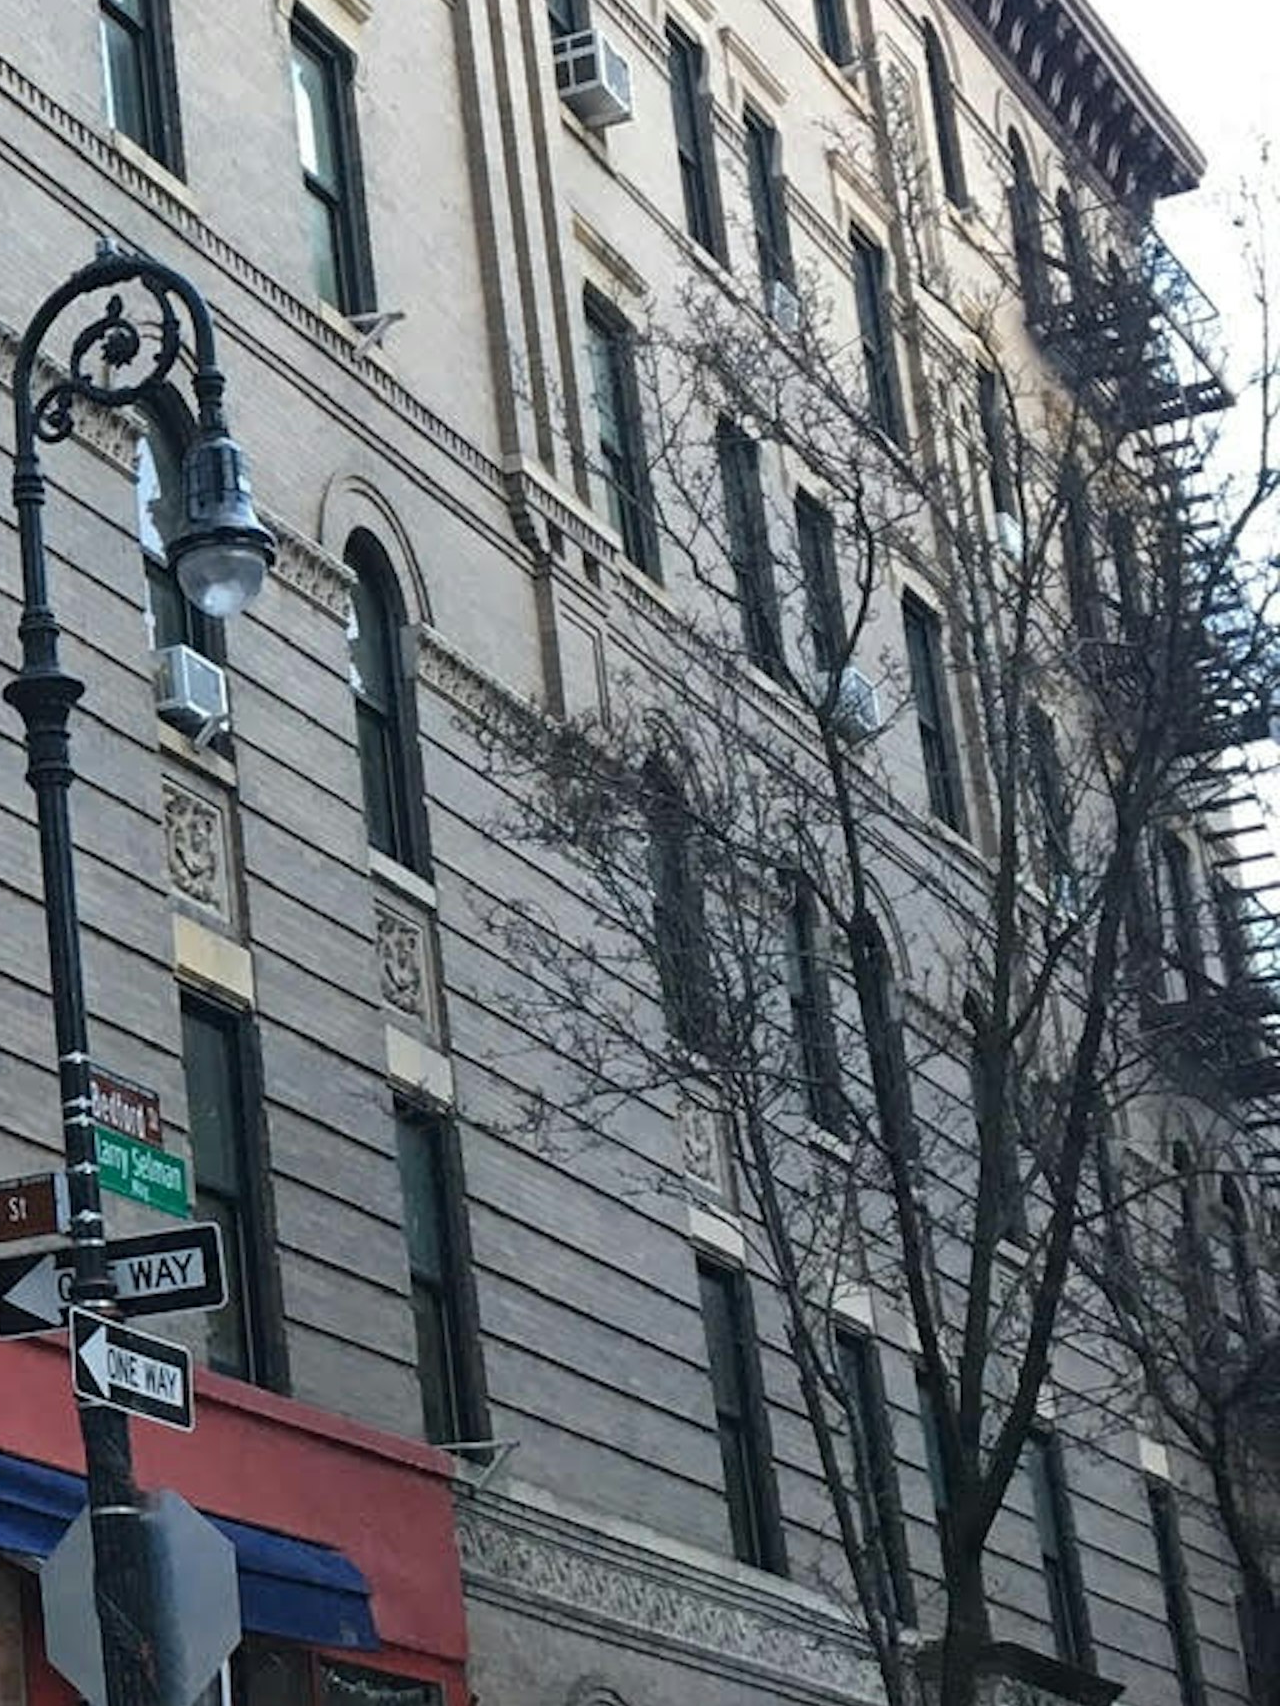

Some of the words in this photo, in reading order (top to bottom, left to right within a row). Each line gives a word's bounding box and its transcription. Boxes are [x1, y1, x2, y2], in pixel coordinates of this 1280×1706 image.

[95, 1127, 129, 1179] Larry
[131, 1147, 182, 1192] Selman
[8, 1196, 28, 1222] St
[128, 1252, 193, 1291] WAY
[107, 1348, 139, 1388] ONE
[143, 1366, 178, 1400] WAY
